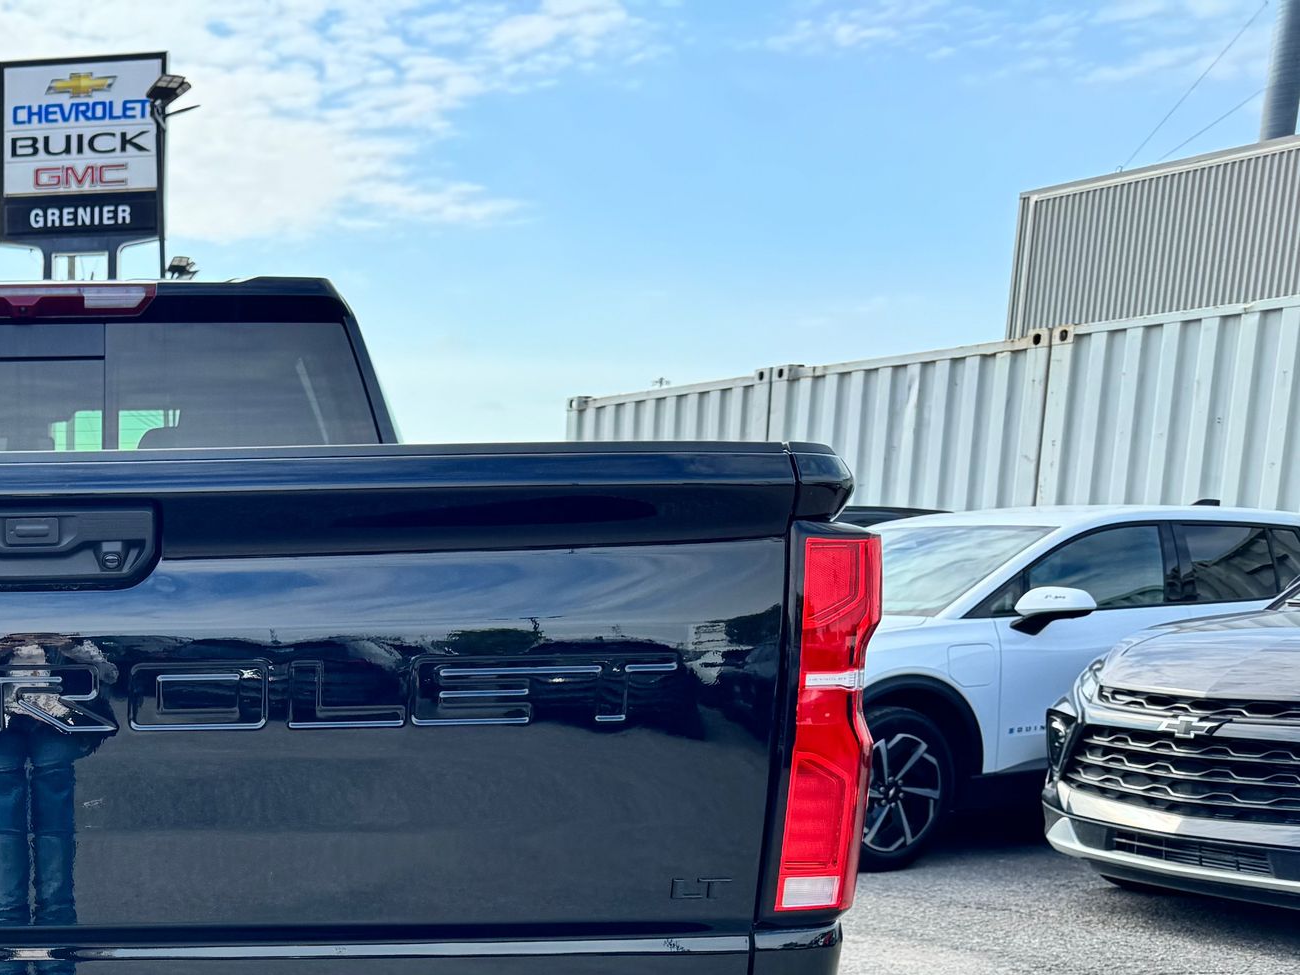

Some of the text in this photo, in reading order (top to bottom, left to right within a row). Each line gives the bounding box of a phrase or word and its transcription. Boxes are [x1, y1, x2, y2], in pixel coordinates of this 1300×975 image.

[12, 99, 151, 126] CHEVROLET
[11, 130, 151, 158] BUICK
[33, 163, 129, 190] GMC
[29, 204, 132, 229] GRENIER
[670, 877, 733, 900] LT
